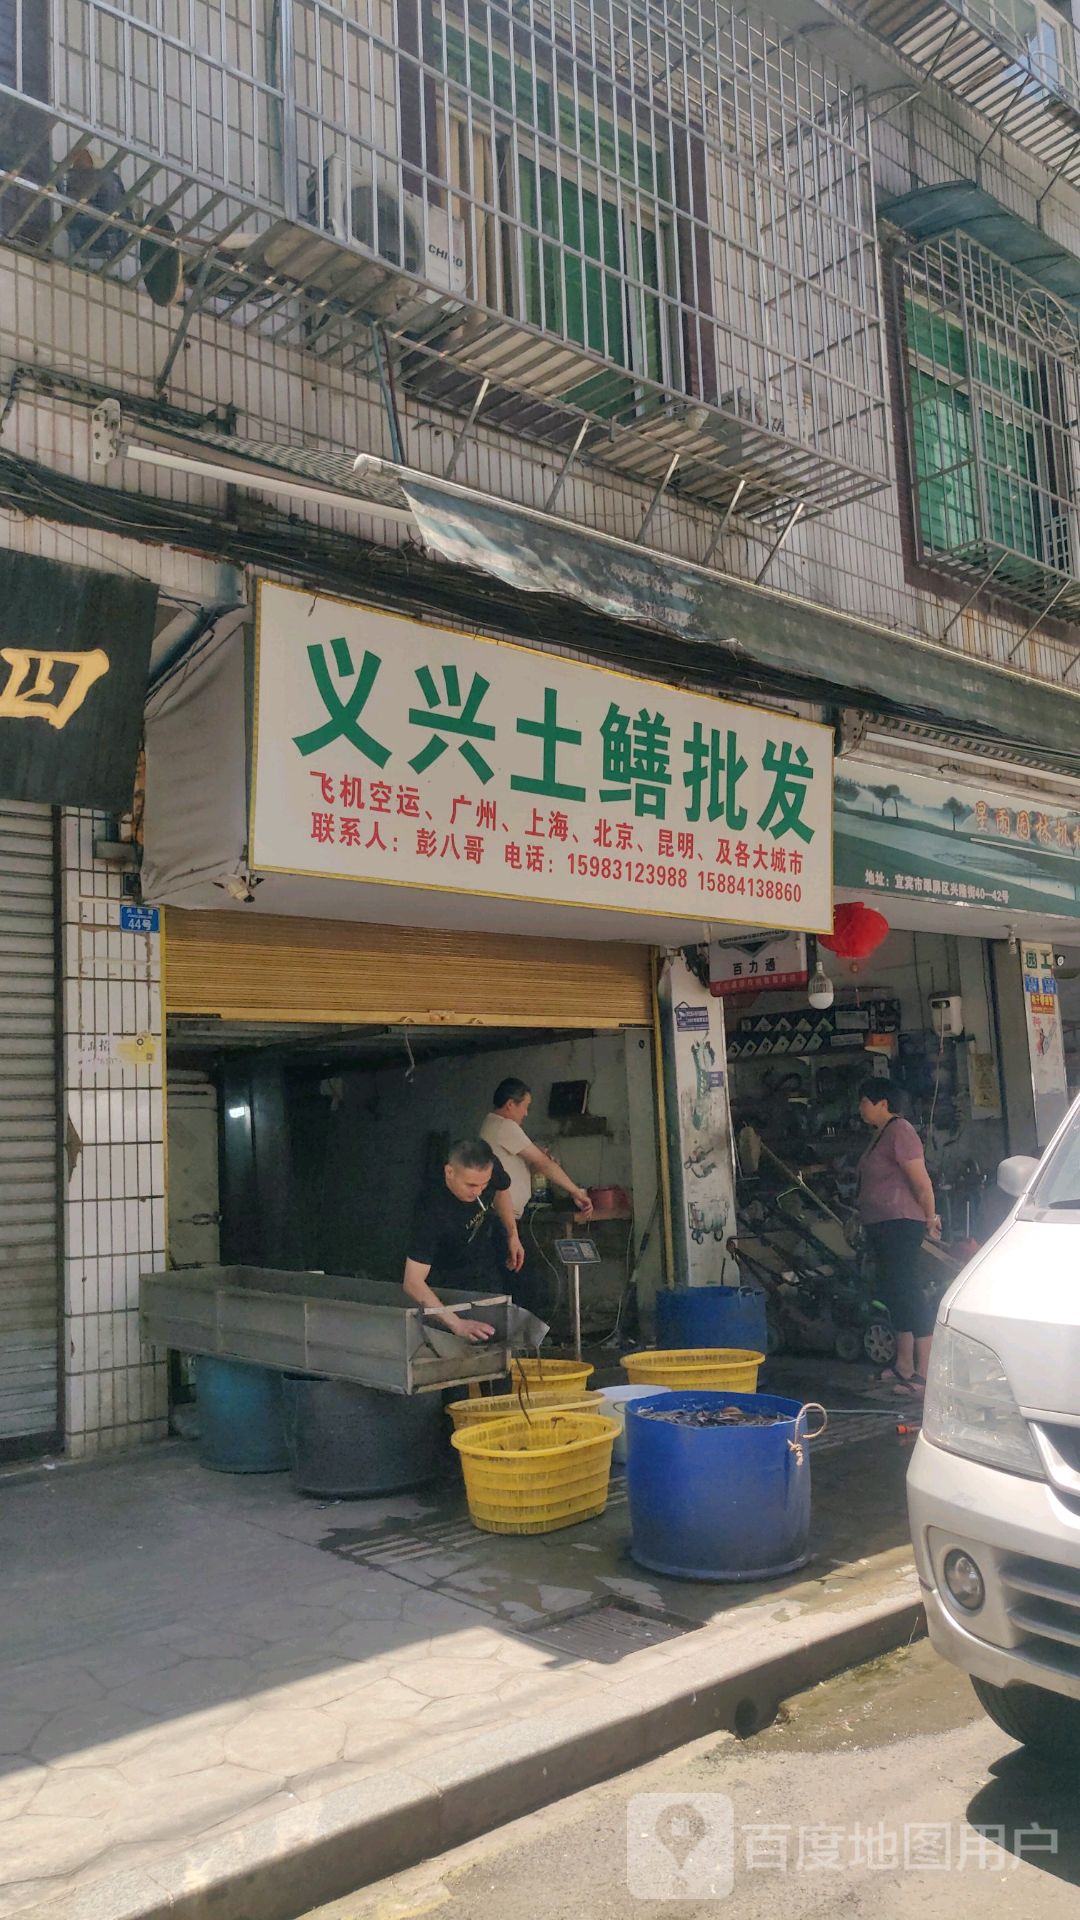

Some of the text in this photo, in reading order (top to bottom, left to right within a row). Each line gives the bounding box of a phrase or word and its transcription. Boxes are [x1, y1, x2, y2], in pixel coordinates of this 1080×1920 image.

[428, 243, 463, 268] CHIO
[291, 636, 816, 844] 义兴土鳝批发
[697, 870, 803, 903] 15884138860
[732, 957, 777, 976] 百力通
